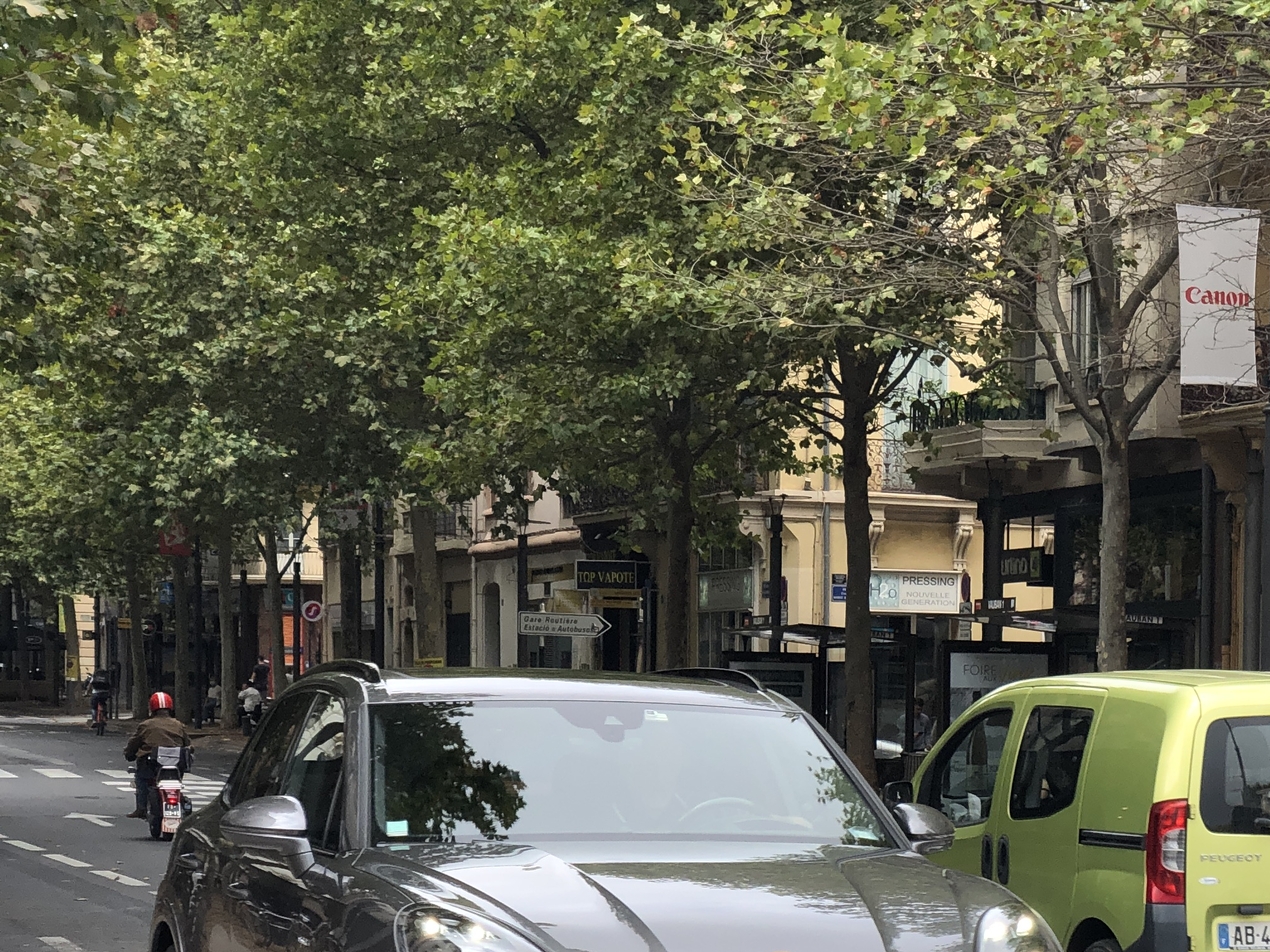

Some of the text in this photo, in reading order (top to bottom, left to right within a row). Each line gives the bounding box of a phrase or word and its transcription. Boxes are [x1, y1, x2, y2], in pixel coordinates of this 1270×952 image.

[1185, 286, 1249, 307] Canon
[578, 571, 595, 584] TOP
[598, 571, 635, 584] VAPOTE
[902, 575, 955, 587] PRESSING
[906, 591, 950, 599] NOUVELLE
[524, 616, 542, 624] Gare
[963, 664, 997, 676] FOIRE
[1200, 853, 1263, 863] PEUGEOT
